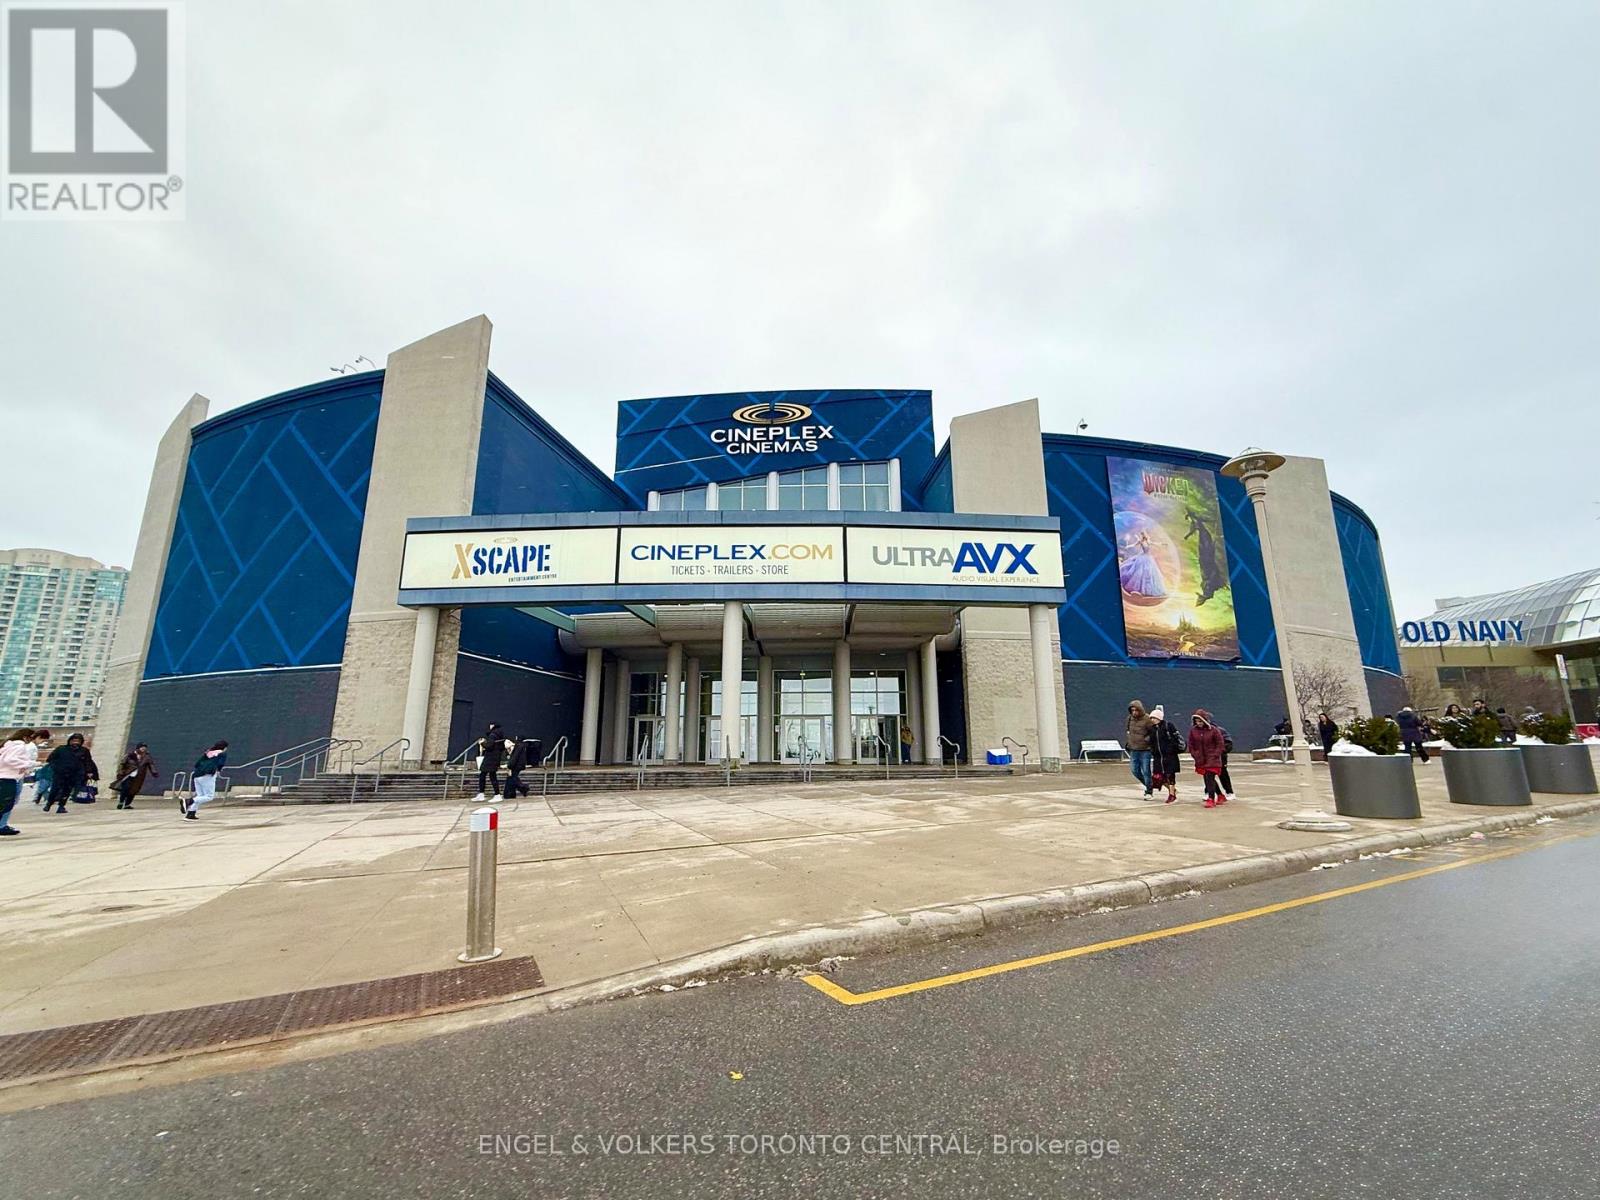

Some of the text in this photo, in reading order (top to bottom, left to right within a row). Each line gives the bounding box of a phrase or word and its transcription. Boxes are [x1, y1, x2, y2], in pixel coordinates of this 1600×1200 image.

[710, 425, 834, 443] CINEPLEX
[726, 440, 819, 454] CINEMAS
[451, 543, 551, 579] XSCAPE
[631, 544, 833, 561] CINEPLEX.COM
[671, 564, 789, 576] TICKETS TRAILERS STORE
[952, 575, 976, 583] AUDIO
[1001, 576, 1040, 584] EXPERIENCE
[1402, 620, 1524, 643] OLD NAVY
